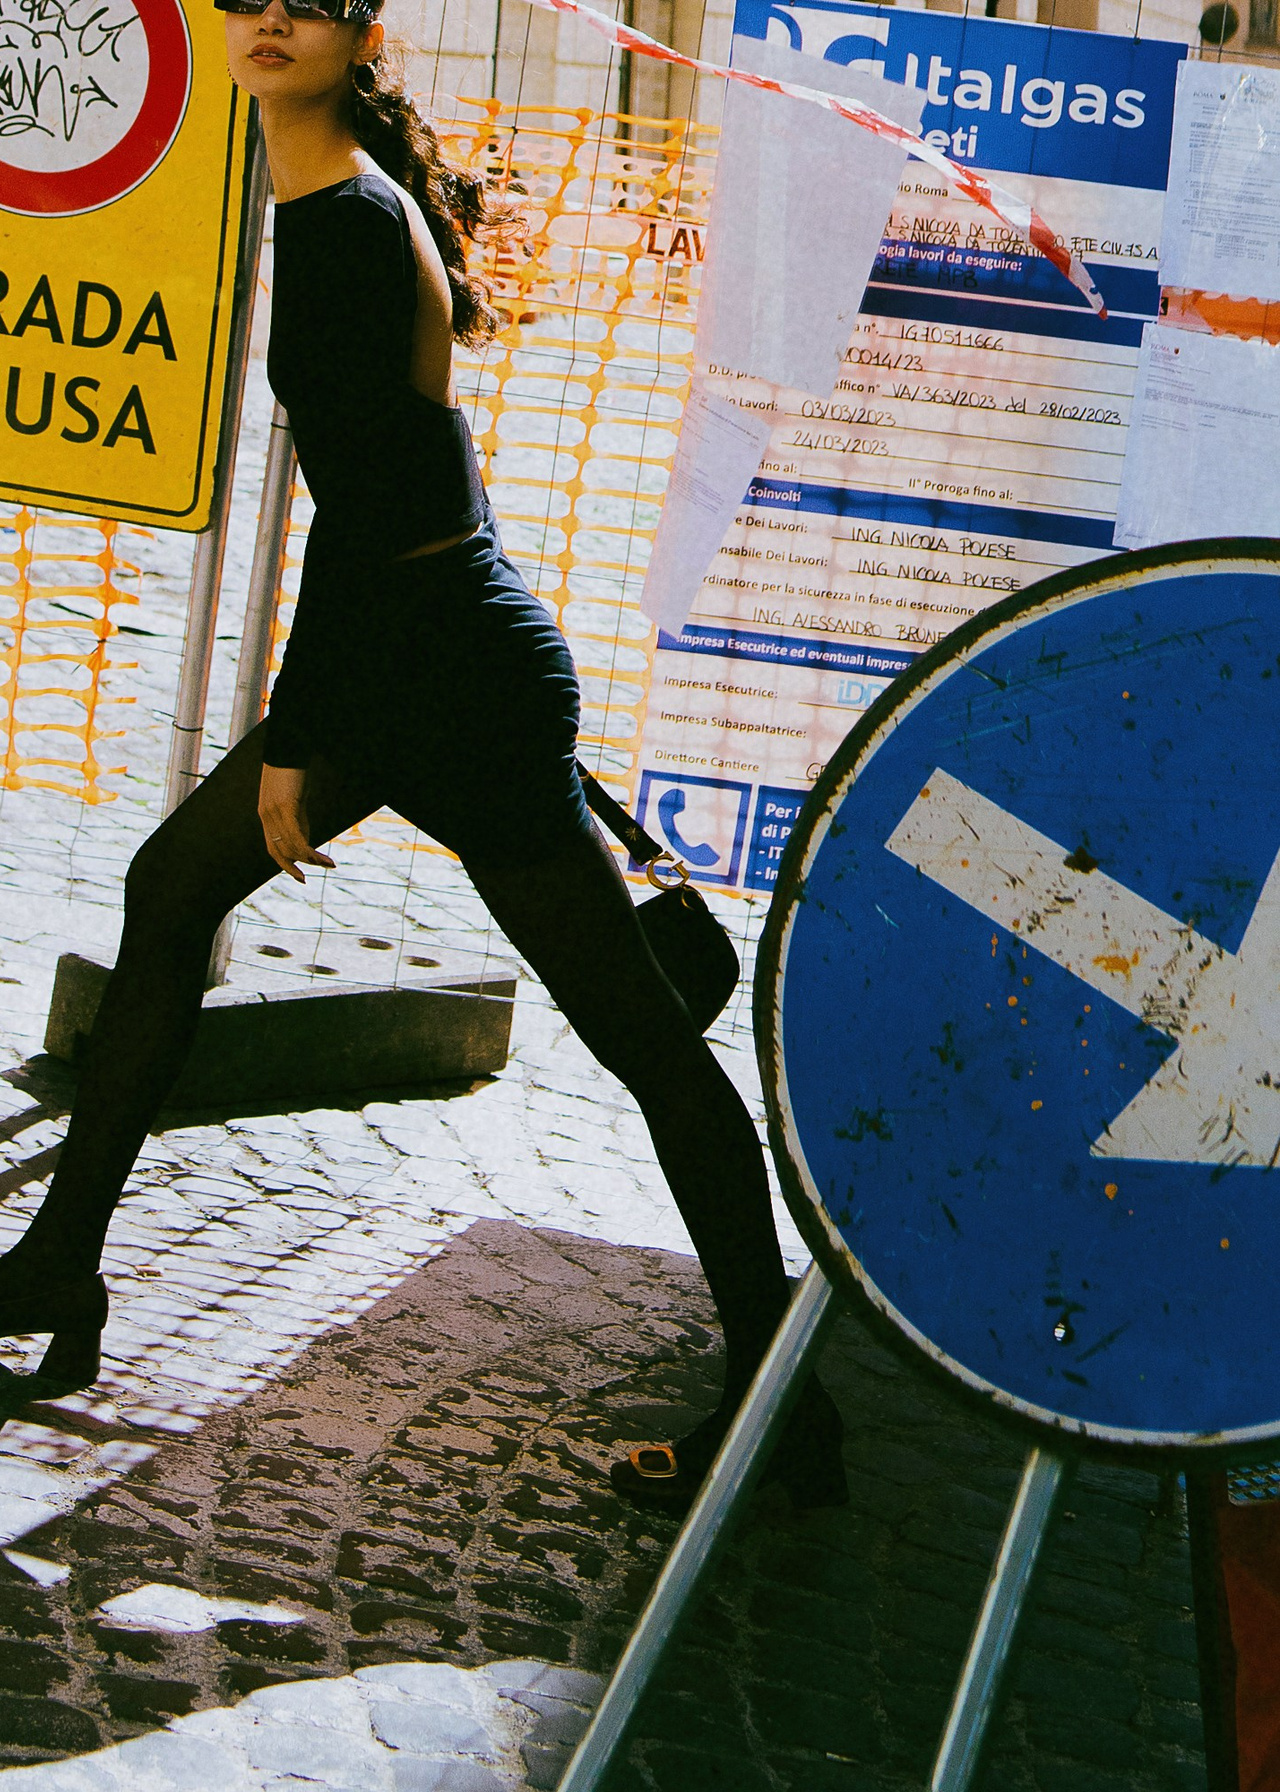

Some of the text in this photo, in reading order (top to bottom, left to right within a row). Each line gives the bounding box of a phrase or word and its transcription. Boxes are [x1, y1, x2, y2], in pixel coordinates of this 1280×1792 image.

[915, 123, 979, 159] eti
[915, 184, 949, 197] Roma
[647, 223, 705, 262] LAV
[969, 222, 986, 239] DA
[1146, 246, 1159, 260] A
[908, 246, 944, 262] lavori
[946, 251, 962, 265] da
[965, 255, 1022, 271] eseguire:
[739, 397, 779, 413] Lavori:
[801, 399, 897, 427] 03/03/2023
[1039, 401, 1122, 426] 28/02/2023
[792, 429, 890, 457] 24/03/2023
[748, 485, 802, 504] Coinvolti
[782, 461, 798, 475] al:
[924, 480, 970, 497] Proroga
[973, 484, 996, 499] fino
[999, 488, 1014, 502] al:
[746, 515, 765, 528] Dei
[768, 518, 808, 534] Lavori:
[890, 530, 950, 554] NICOLA
[959, 535, 1017, 560] POLESE
[718, 545, 762, 559] nsabile
[766, 549, 786, 562] Dei
[788, 550, 828, 568] Lavori:
[897, 563, 951, 585] NICOLA
[962, 570, 1022, 592] POLESE
[703, 573, 758, 590] rdinatore
[761, 581, 781, 594] per
[784, 582, 795, 595] la
[798, 585, 851, 603] sicurezza
[854, 591, 866, 604] in
[868, 592, 892, 607] fase
[895, 595, 907, 608] di
[910, 599, 975, 617] esecuzione
[793, 612, 883, 638] ALESSANDRO
[727, 638, 788, 657] Esecutrice
[790, 646, 807, 659] ed
[808, 649, 865, 667] eventuali
[664, 675, 711, 691] Impresa
[715, 682, 778, 699] Esecutrice:
[660, 711, 807, 739] Impresa Subappaltatrice:
[654, 749, 760, 773] Direttore Cantiere
[765, 802, 792, 819] Per
[762, 824, 778, 839] di
